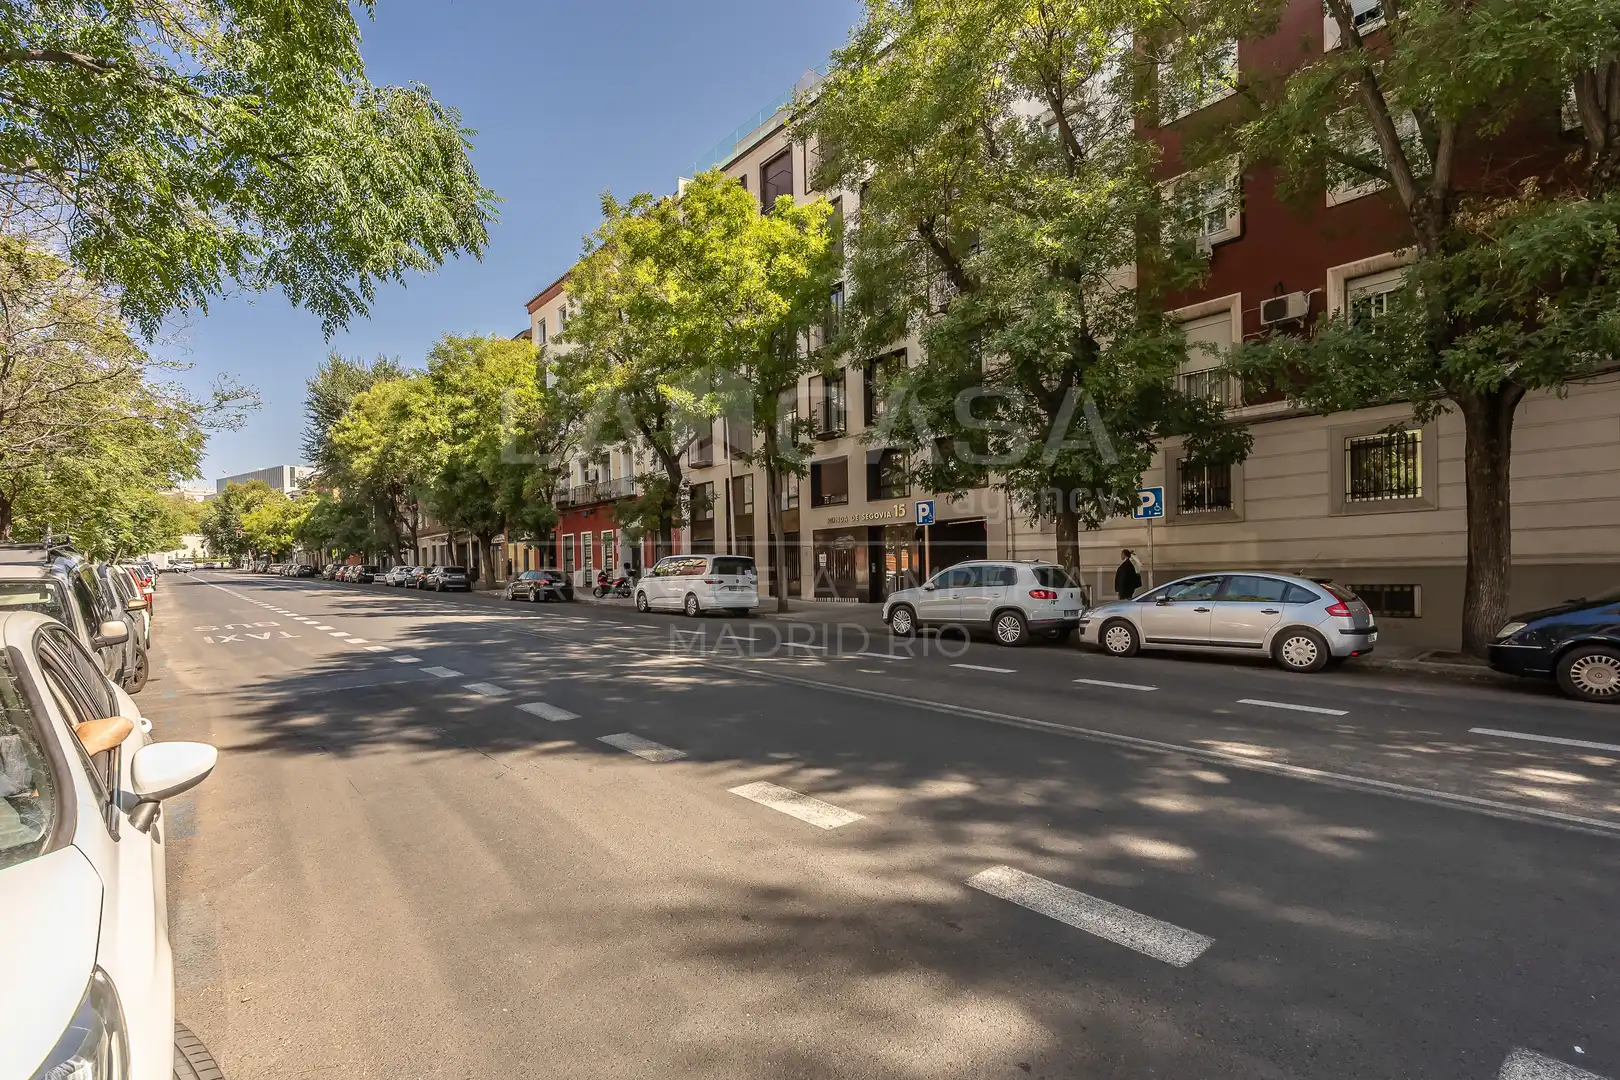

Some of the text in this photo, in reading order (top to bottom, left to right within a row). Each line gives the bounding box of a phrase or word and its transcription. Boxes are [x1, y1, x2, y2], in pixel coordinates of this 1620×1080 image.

[852, 514, 860, 522] DE
[862, 511, 892, 520] SEGOVIA
[893, 503, 906, 517] 15
[918, 503, 930, 522] P
[1137, 491, 1156, 515] P
[203, 631, 302, 644] TAXI
